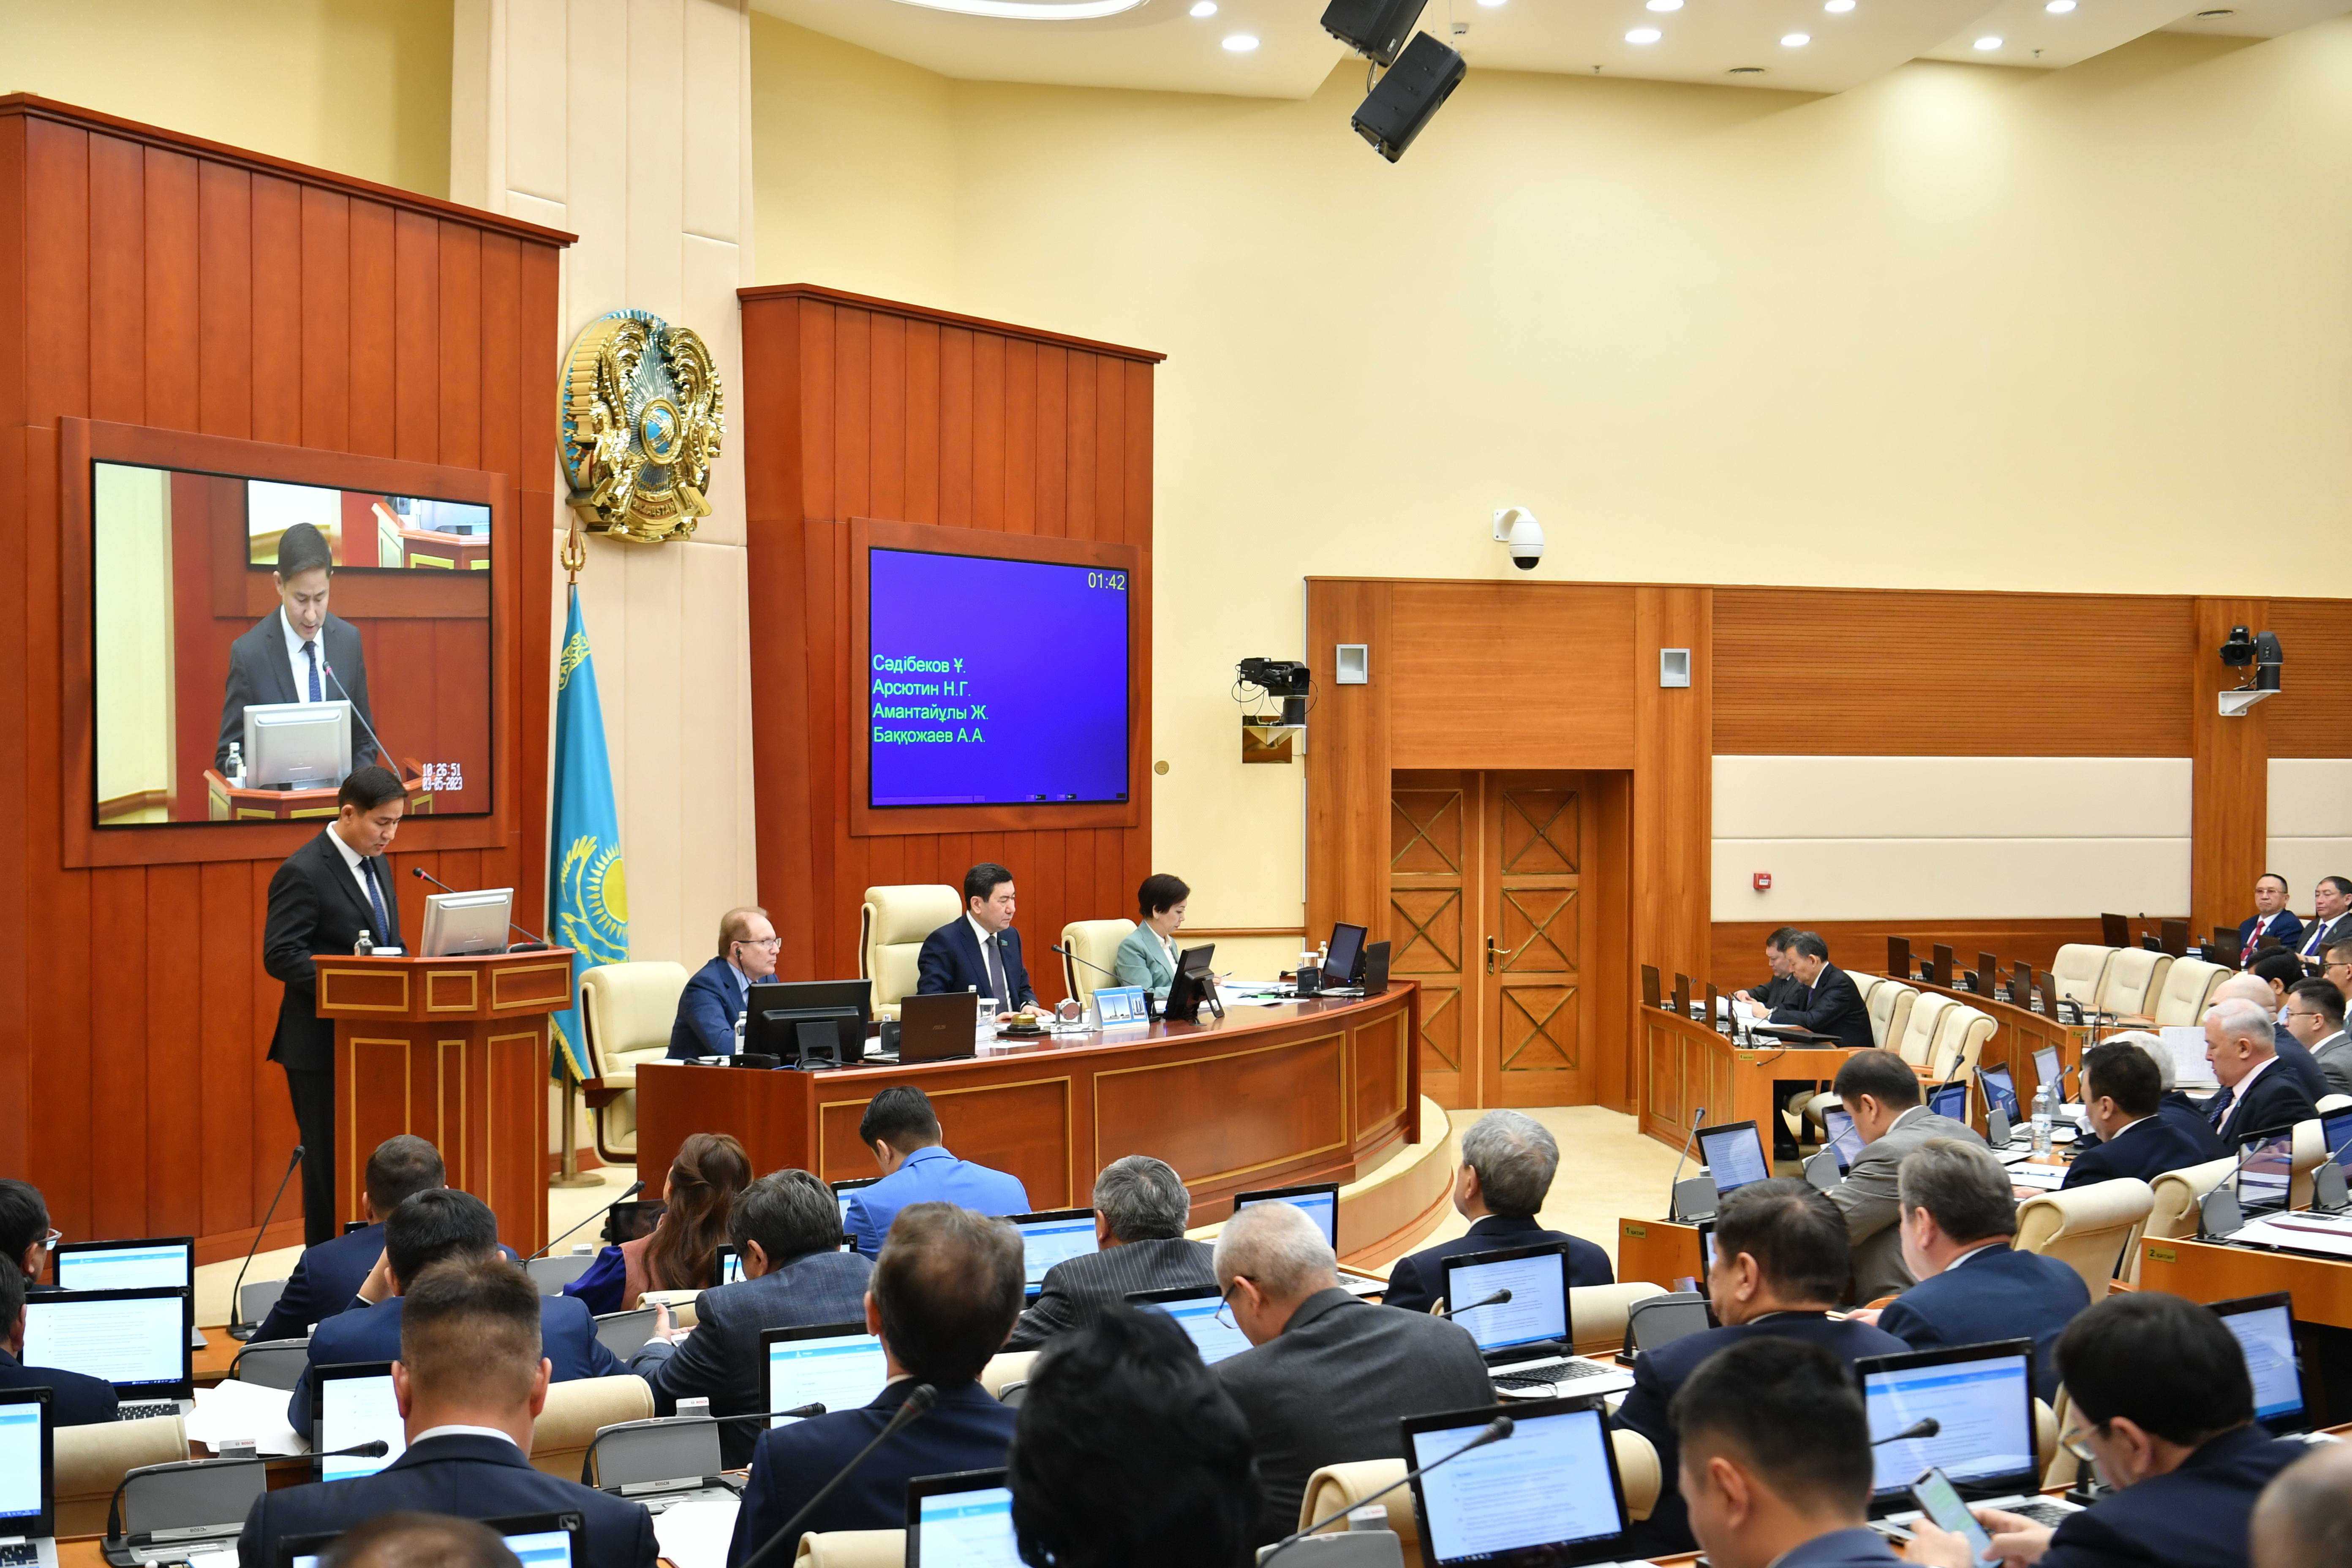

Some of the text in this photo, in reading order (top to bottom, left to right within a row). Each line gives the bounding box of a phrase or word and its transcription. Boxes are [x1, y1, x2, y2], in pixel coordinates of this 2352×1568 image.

[1088, 572, 1125, 590] 01:42
[873, 654, 950, 674] Сәдібеков
[872, 678, 971, 698] Арсютин Н.Г.
[872, 702, 989, 723] Амантайұлы Ж.
[874, 727, 985, 745] Баққожаев А.А.
[422, 763, 461, 777] 10:26:51
[422, 776, 463, 791] 03-05-2023
